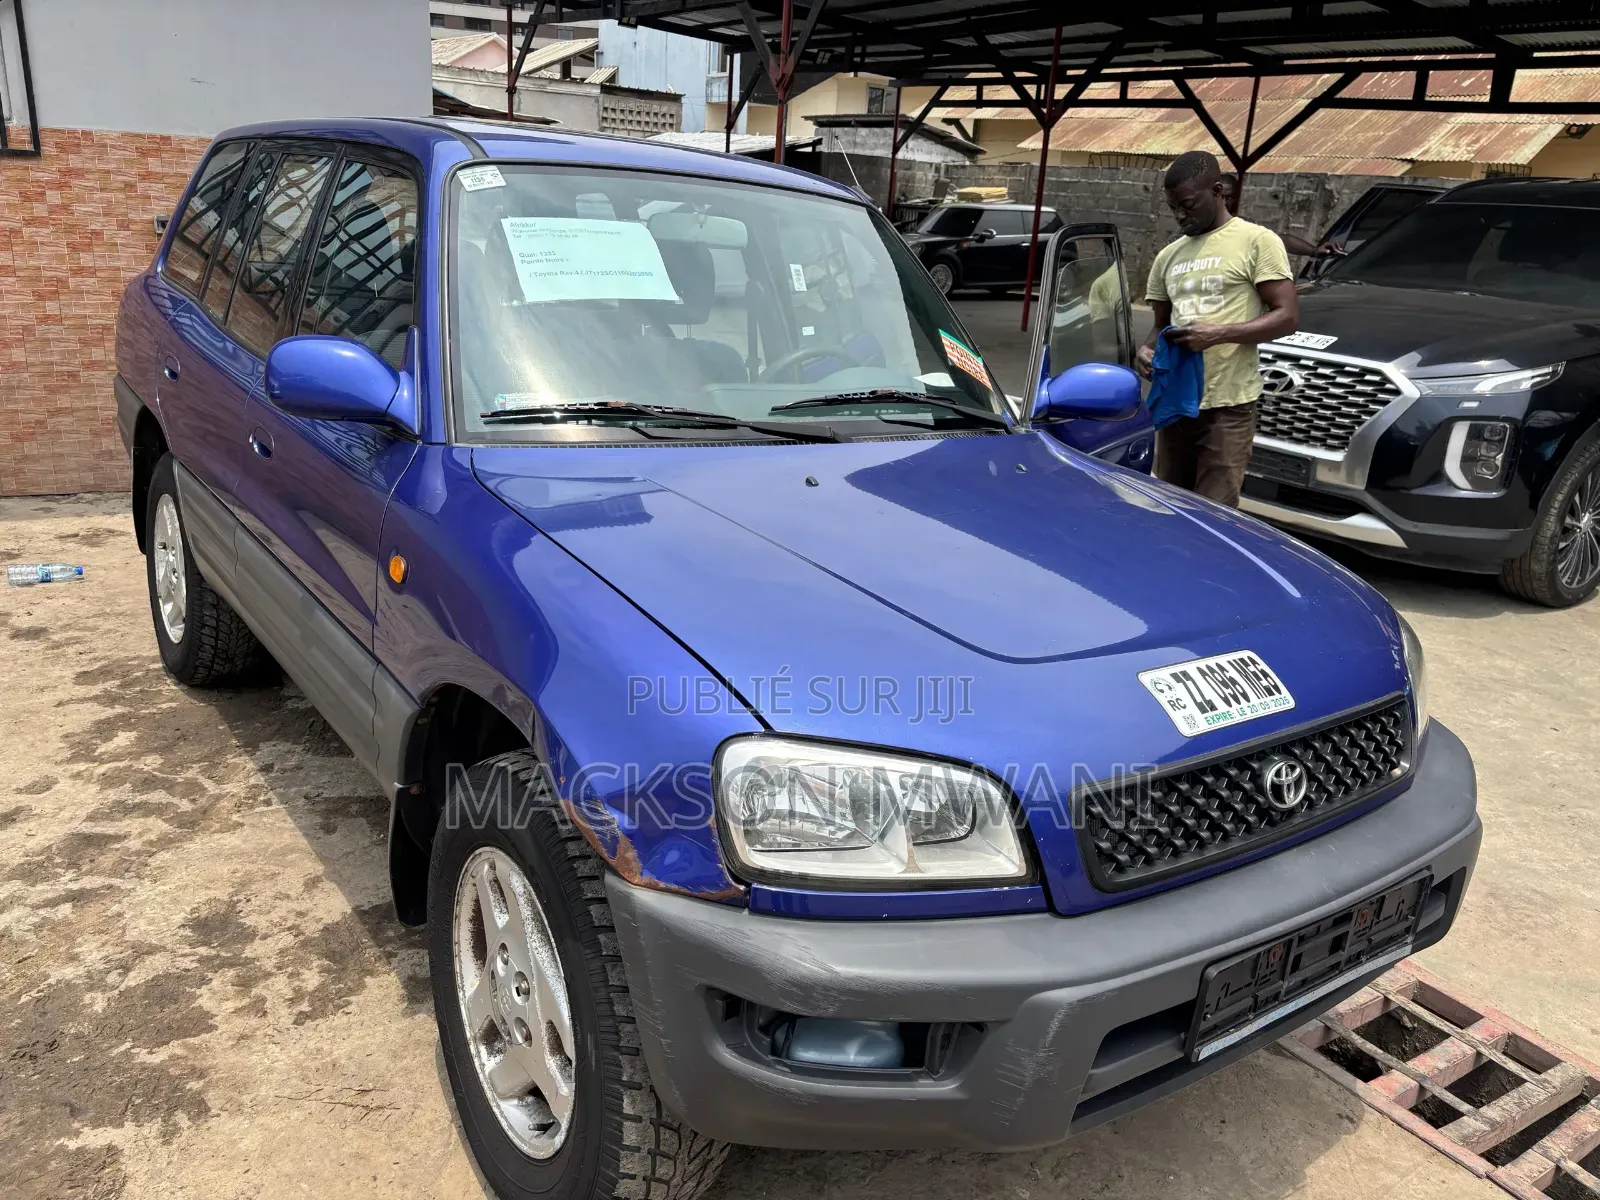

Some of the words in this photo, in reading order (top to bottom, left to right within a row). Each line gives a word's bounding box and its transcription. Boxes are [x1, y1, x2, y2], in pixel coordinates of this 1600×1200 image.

[534, 270, 558, 278] Toyota
[1171, 261, 1192, 276] CALL
[1193, 256, 1222, 271] DUTY
[1169, 669, 1218, 715] ZZ
[1196, 662, 1251, 708] 096
[1167, 697, 1187, 712] RC
[1204, 711, 1236, 726] EXPIRE:
[1238, 707, 1248, 716] LE
